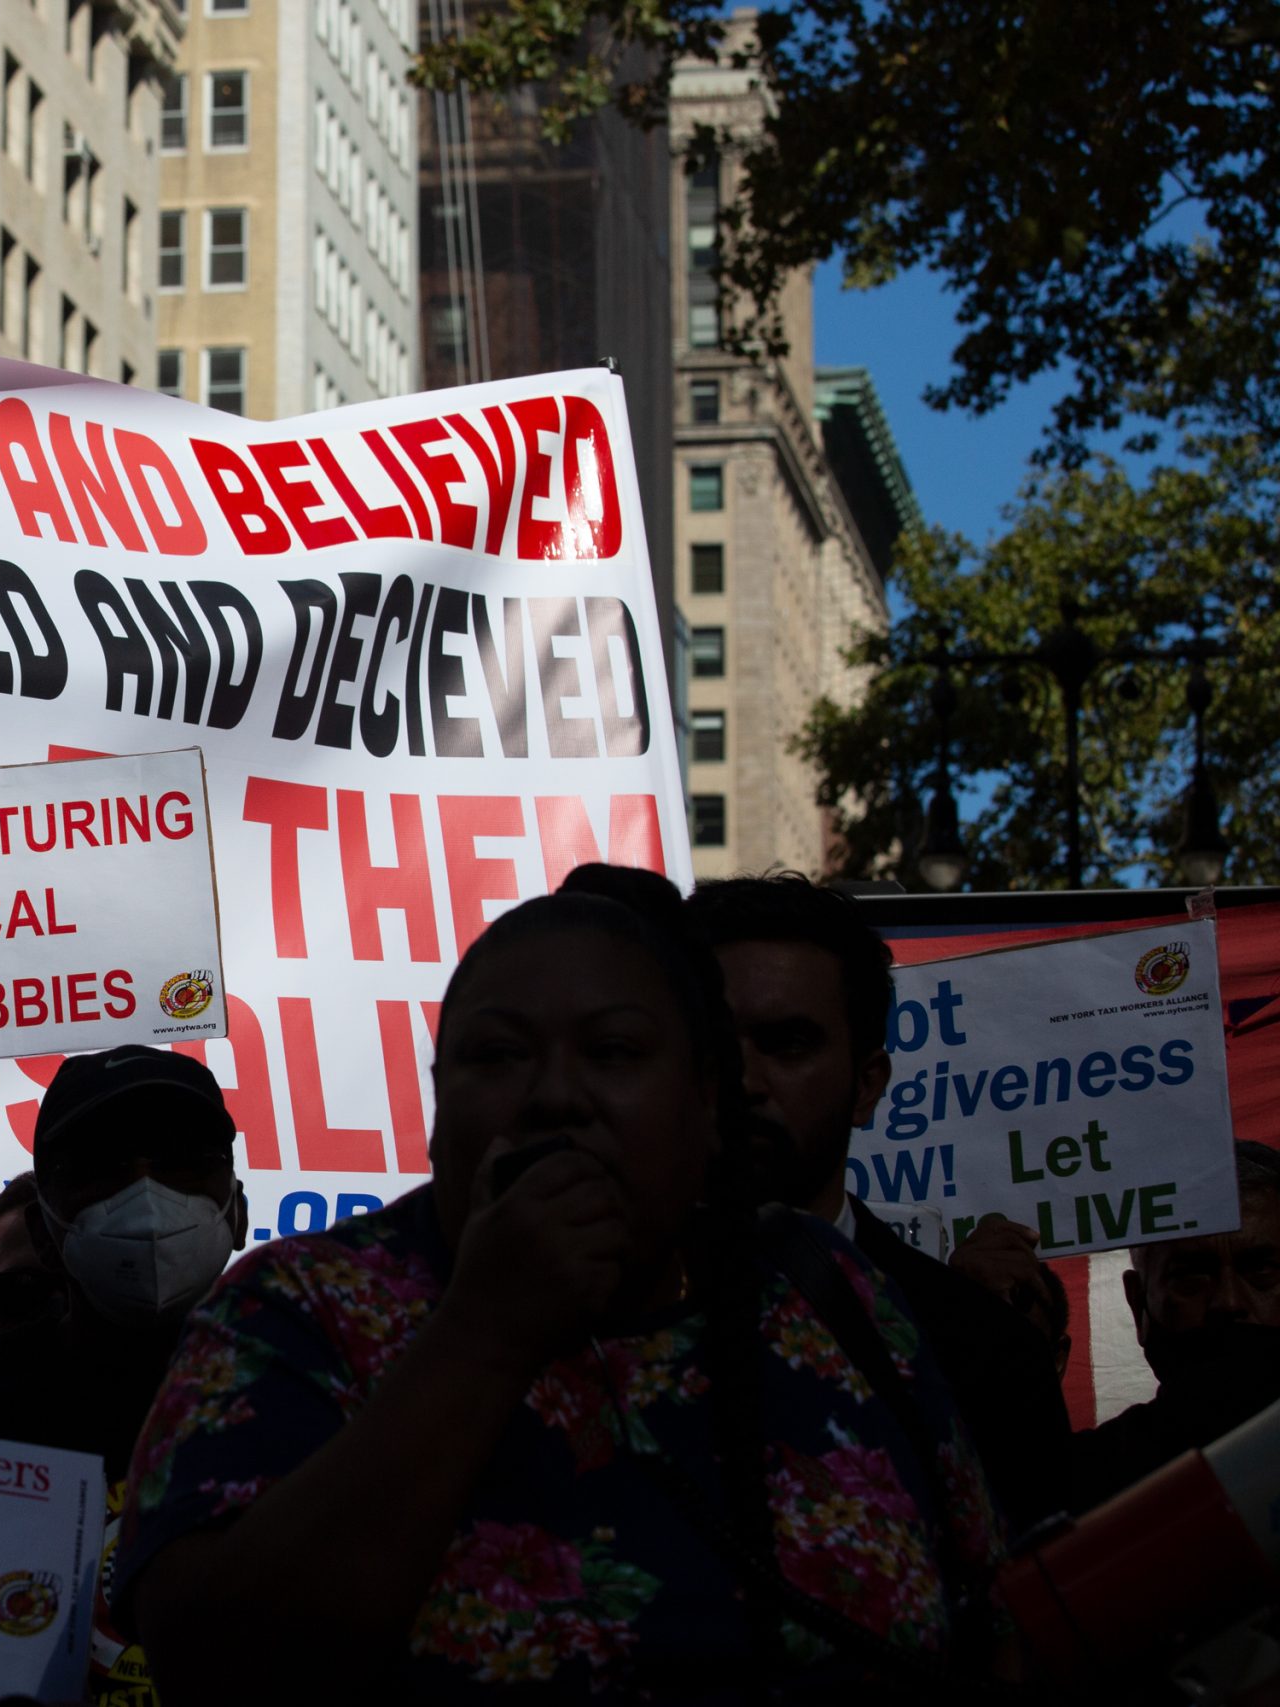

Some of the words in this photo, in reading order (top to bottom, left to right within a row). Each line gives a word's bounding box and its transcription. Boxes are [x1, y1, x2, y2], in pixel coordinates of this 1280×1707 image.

[189, 394, 622, 562] BELIEVED
[74, 569, 263, 731] AND
[271, 572, 651, 759] DECIEVED
[152, 1023, 217, 1035] www.nytwa.org
[1049, 1014, 1069, 1024] NEW
[1071, 1009, 1095, 1021] YORK
[1098, 1006, 1118, 1016] TAXI
[1120, 999, 1164, 1012] WORKERS
[1166, 992, 1209, 1005] ALLIANCE
[1143, 1003, 1209, 1018] www.nytwa.org
[171, 992, 444, 1174] ALI
[1008, 1120, 1111, 1184] Let
[1037, 1182, 1198, 1251] LIVE.
